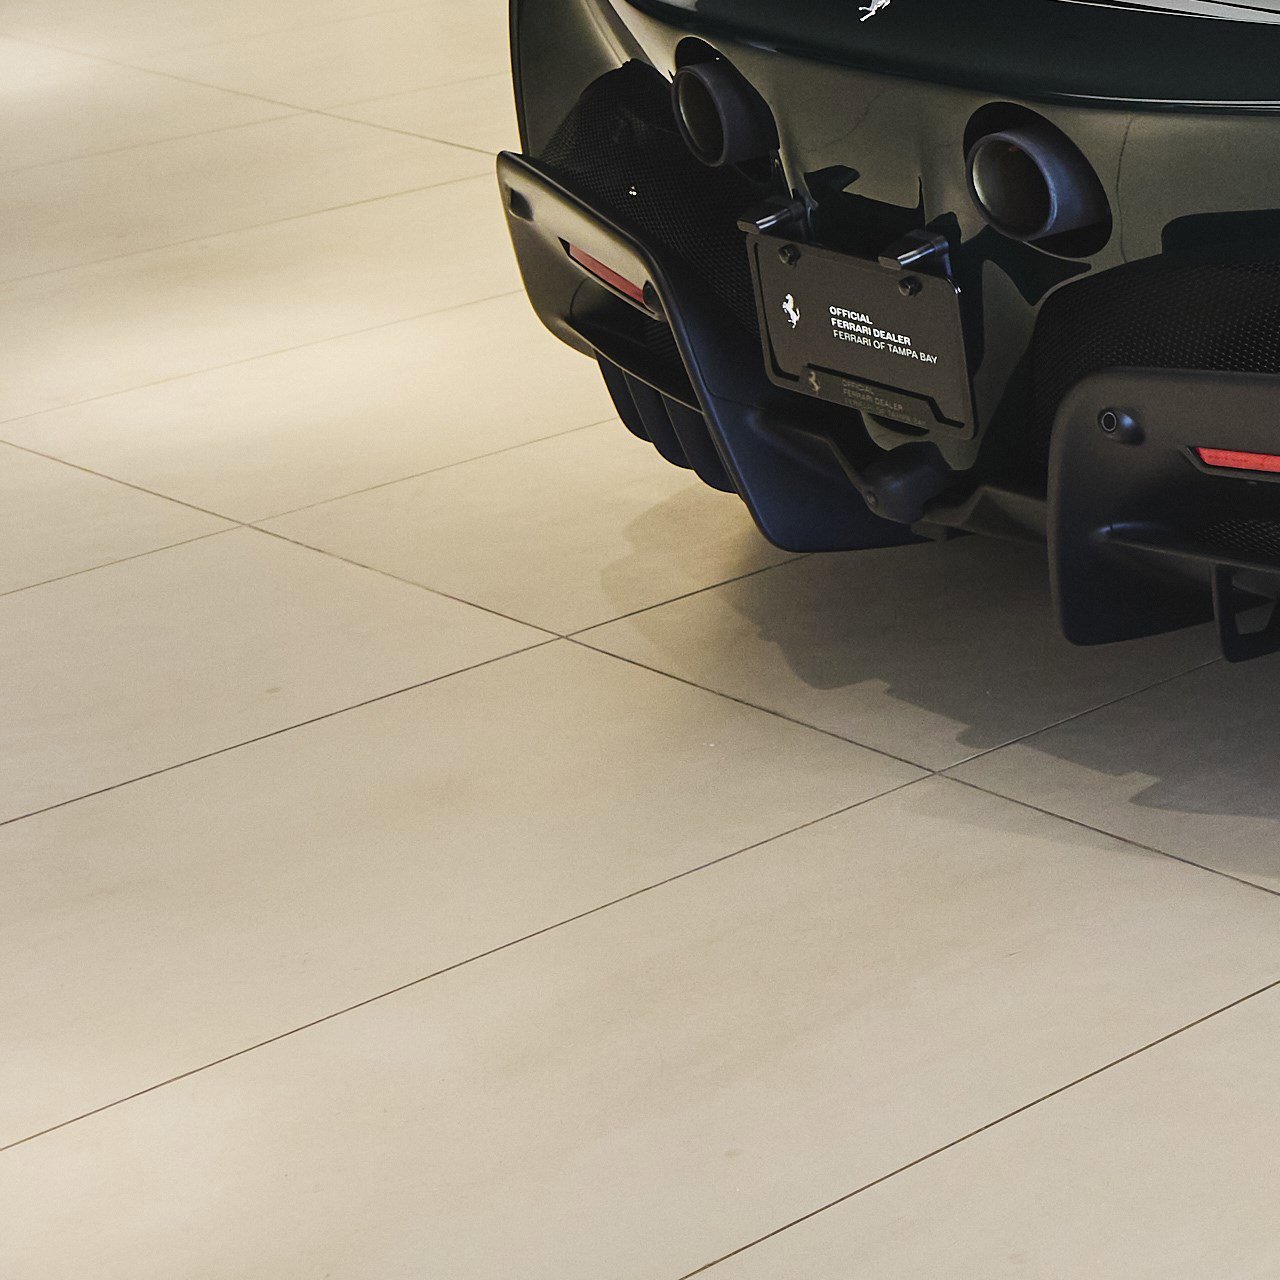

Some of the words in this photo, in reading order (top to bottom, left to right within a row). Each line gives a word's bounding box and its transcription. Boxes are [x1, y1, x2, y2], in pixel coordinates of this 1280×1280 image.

[829, 305, 873, 325] OFFICIAL
[831, 317, 871, 336] FERRARI
[873, 328, 911, 347] DEALER
[833, 329, 871, 347] FERRARI
[873, 340, 886, 350] OF
[887, 343, 918, 360] TAMPA
[920, 351, 938, 364] BAY
